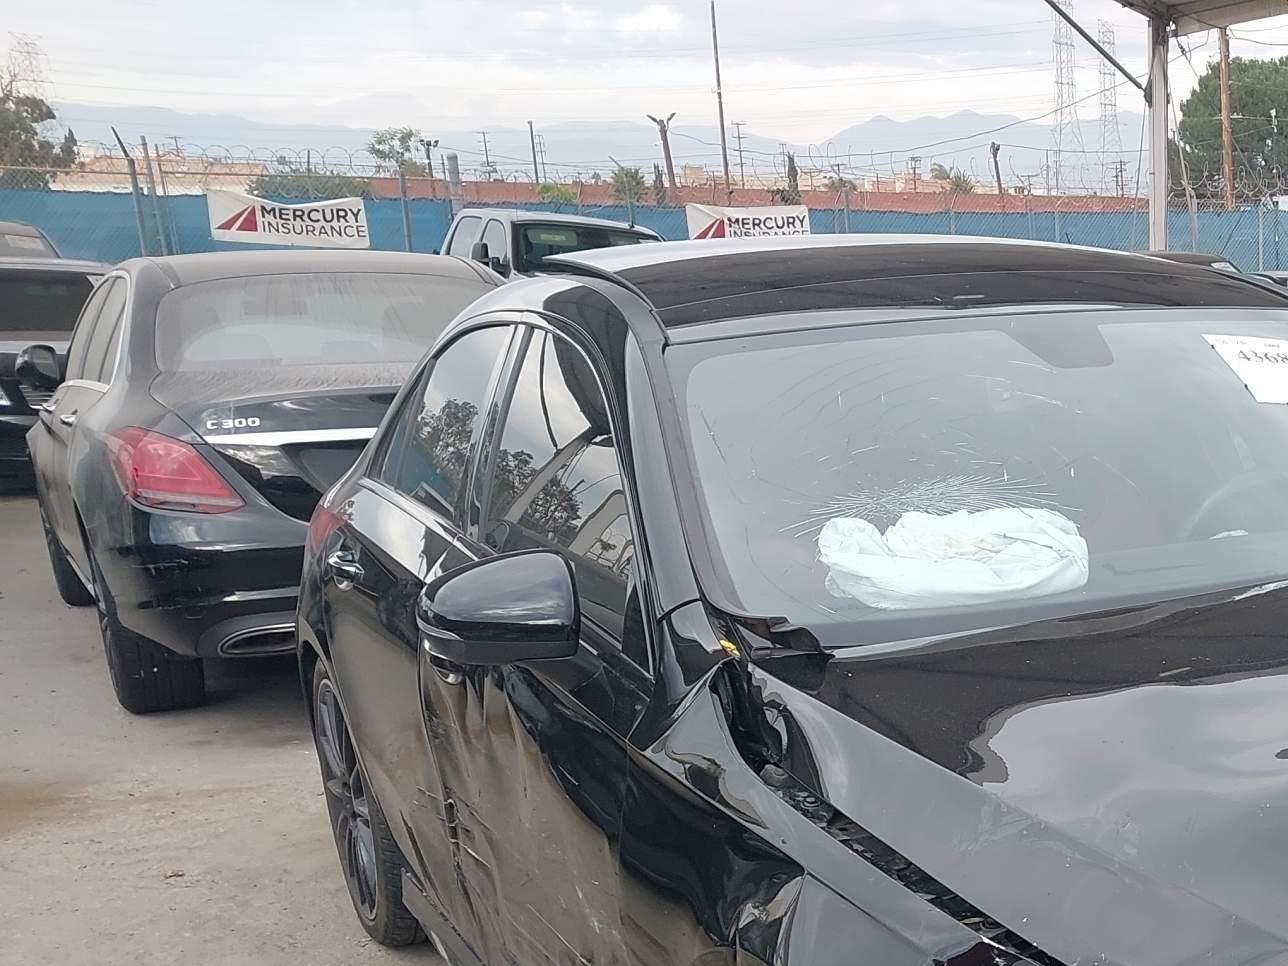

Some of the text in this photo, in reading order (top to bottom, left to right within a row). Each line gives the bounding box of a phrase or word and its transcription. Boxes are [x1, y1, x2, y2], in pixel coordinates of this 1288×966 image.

[260, 205, 361, 223] MERCURY
[262, 220, 367, 238] INSURANCE
[727, 215, 806, 230] MERCURY
[206, 417, 260, 429] C 300
